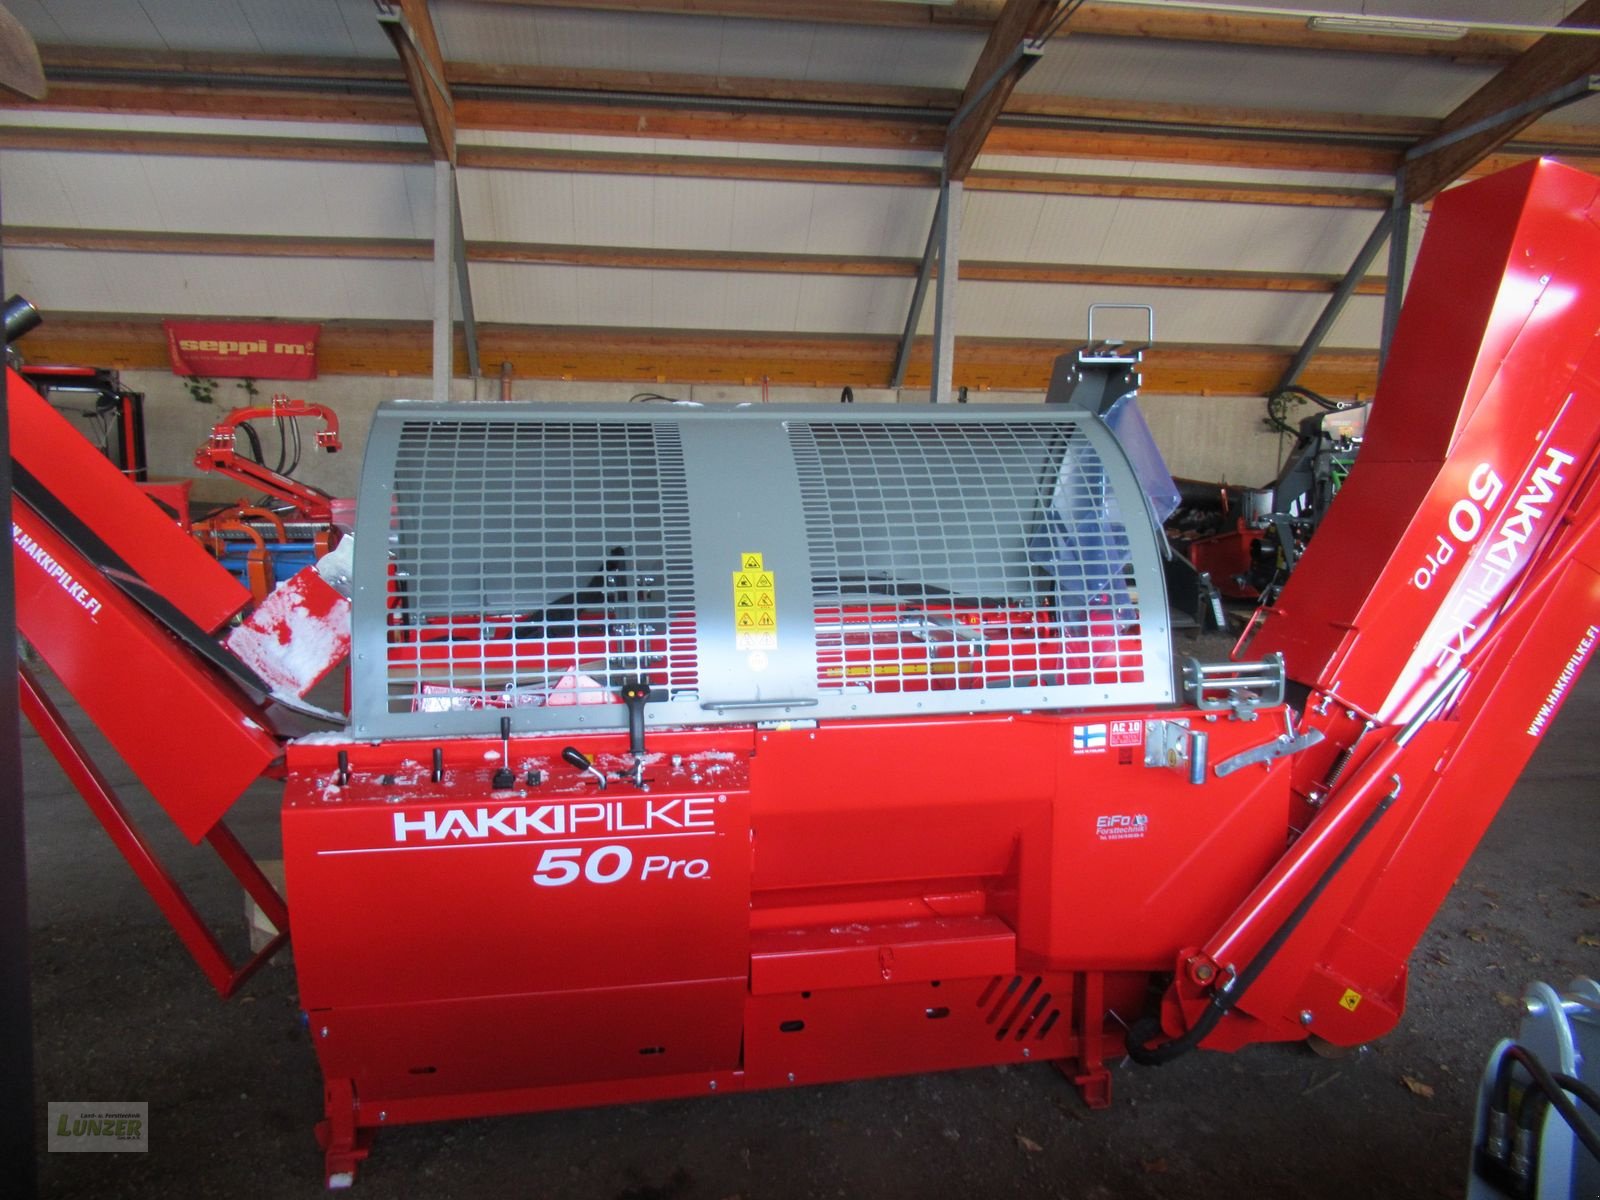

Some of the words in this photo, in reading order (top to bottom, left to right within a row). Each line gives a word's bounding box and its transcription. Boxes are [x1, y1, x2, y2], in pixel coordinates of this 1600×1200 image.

[179, 339, 267, 355] seppi
[274, 342, 305, 355] m
[1448, 463, 1503, 542] 50
[1414, 535, 1455, 590] Pro
[1428, 447, 1575, 672] HAKKIPILKE
[1526, 624, 1600, 737] WWW.HAKKIPILKE.FI
[1112, 722, 1125, 732] AC
[1128, 721, 1140, 732] 10
[393, 797, 715, 842] HAKKIPILKE
[1096, 815, 1131, 827] EiFo
[1096, 825, 1145, 835] Forsttechnik
[533, 845, 633, 887] 50
[640, 855, 709, 881] Pro
